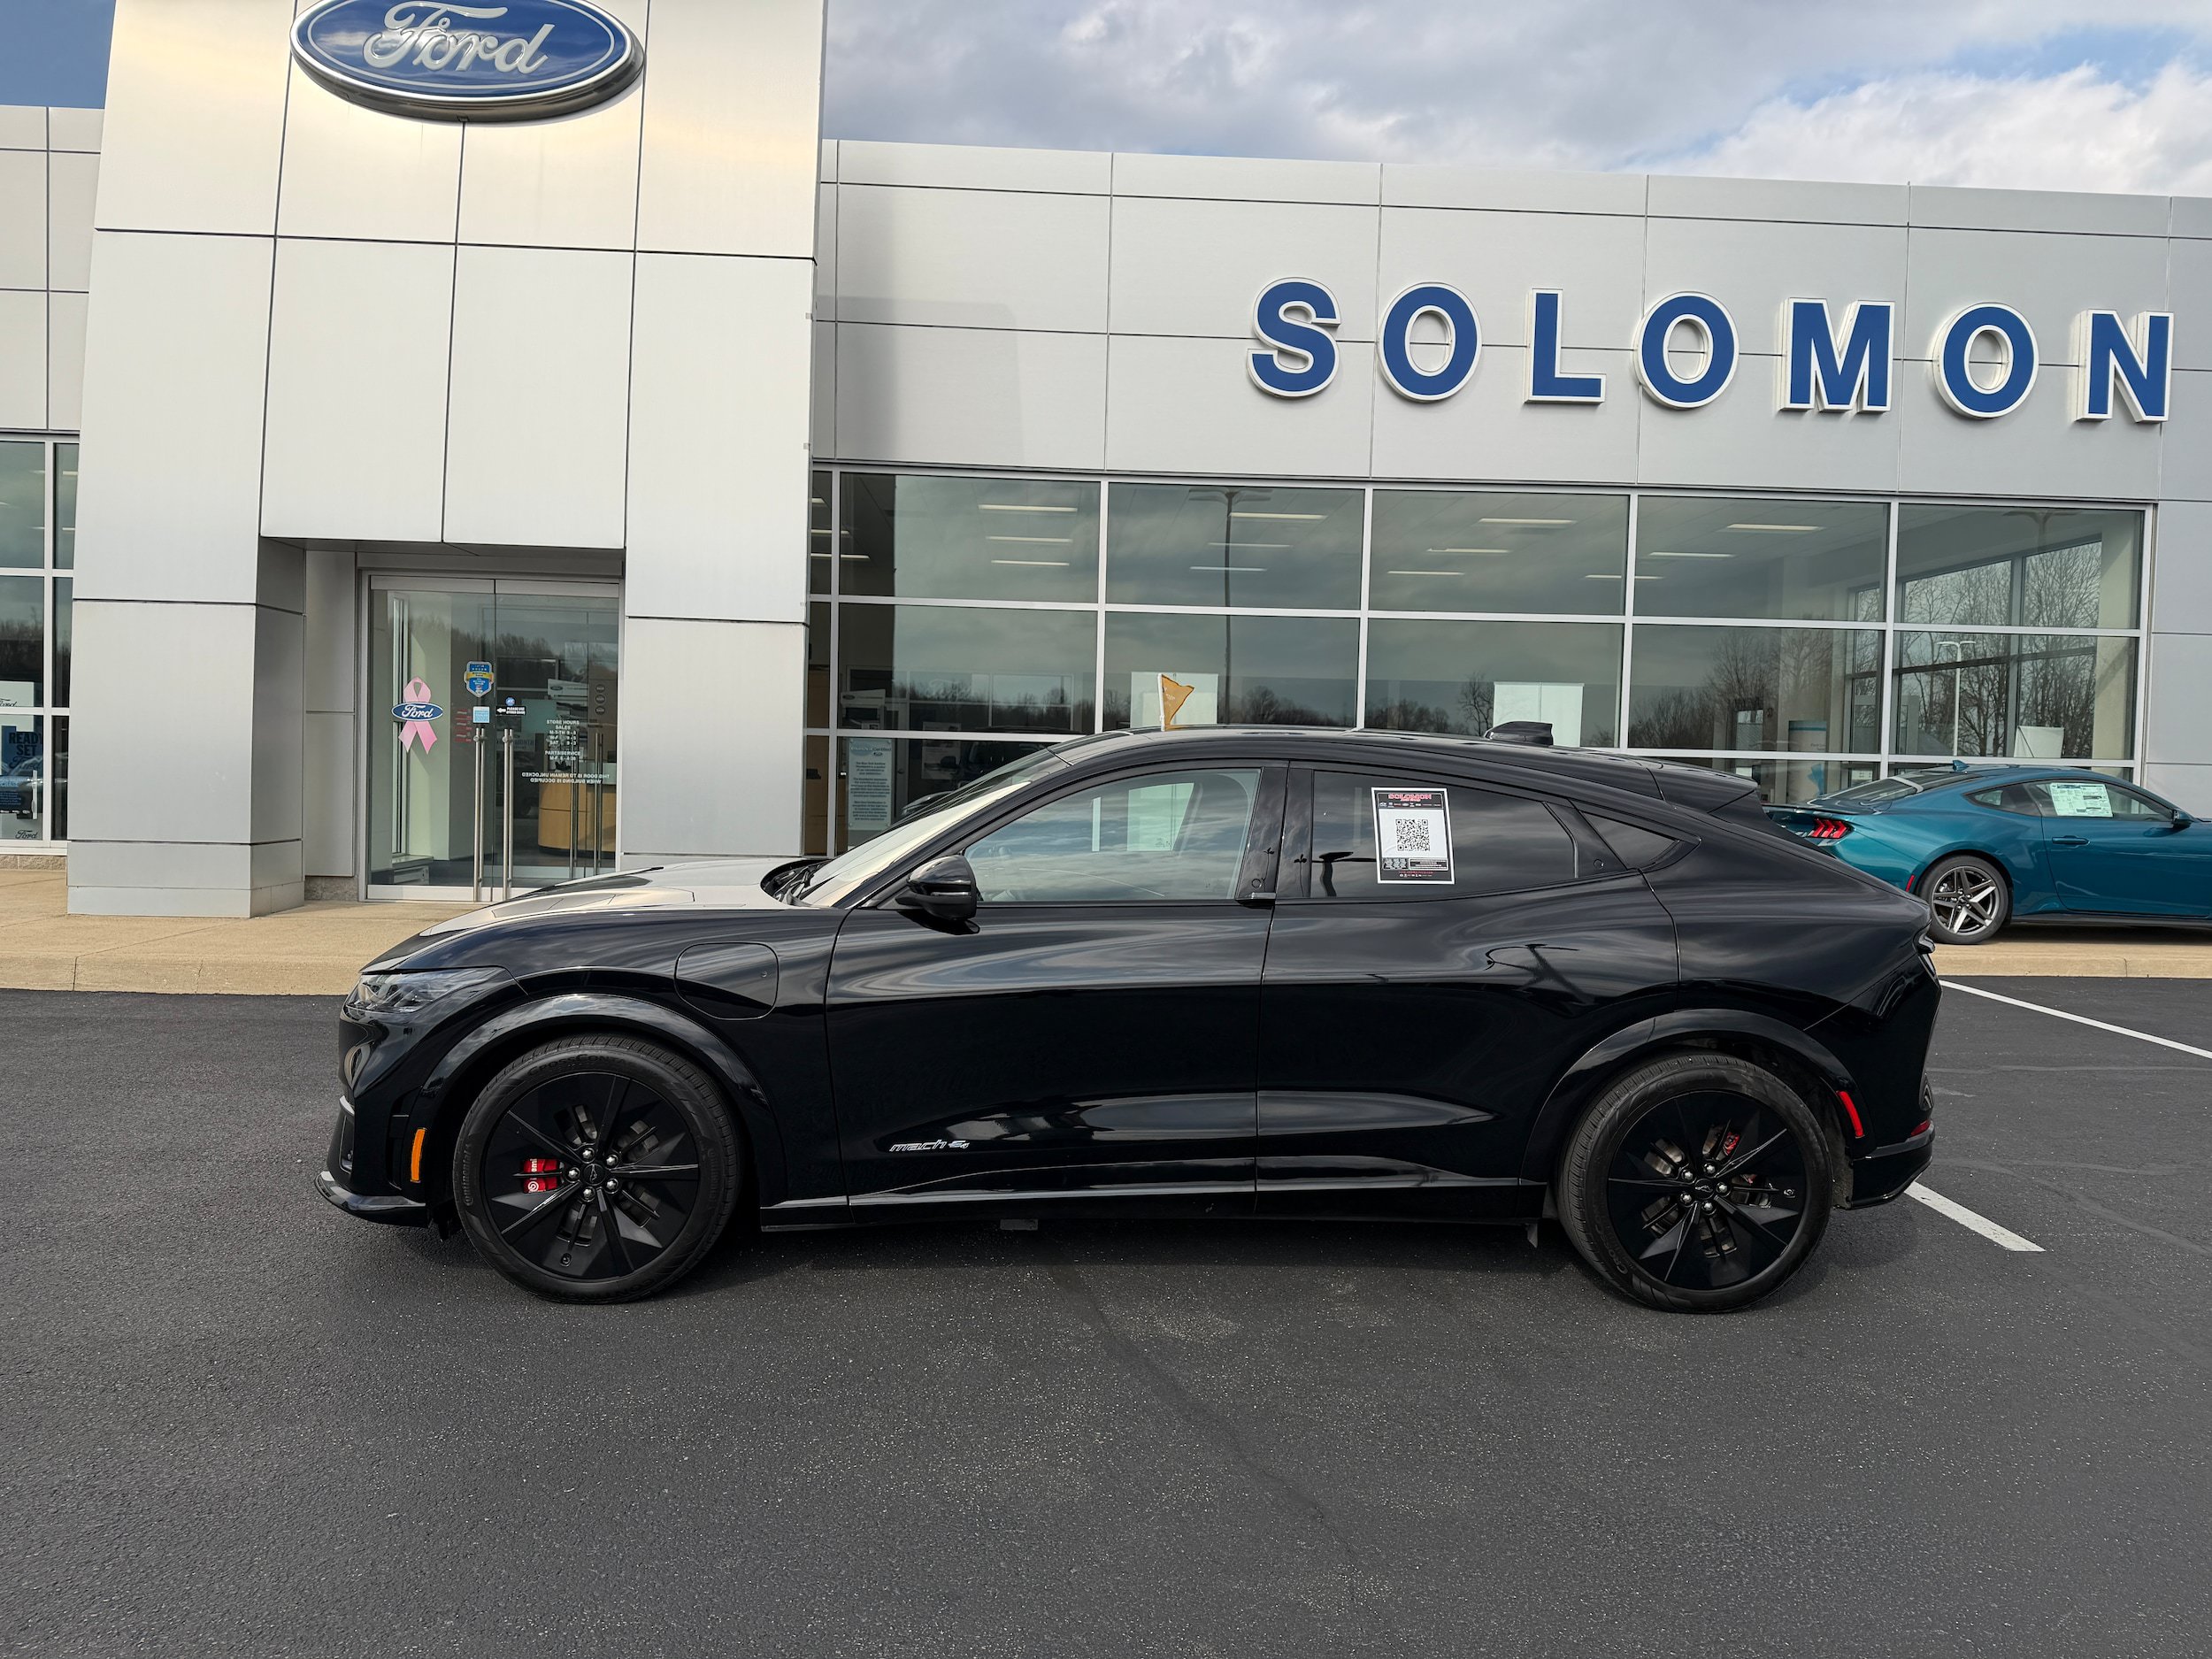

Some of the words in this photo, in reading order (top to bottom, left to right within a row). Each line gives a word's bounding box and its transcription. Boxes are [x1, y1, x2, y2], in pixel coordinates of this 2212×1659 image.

[363, 1, 555, 74] Ford
[1247, 277, 2173, 422] SOLOMON
[402, 704, 434, 718] Ford
[16, 745, 36, 757] SET
[15, 830, 37, 839] Ford
